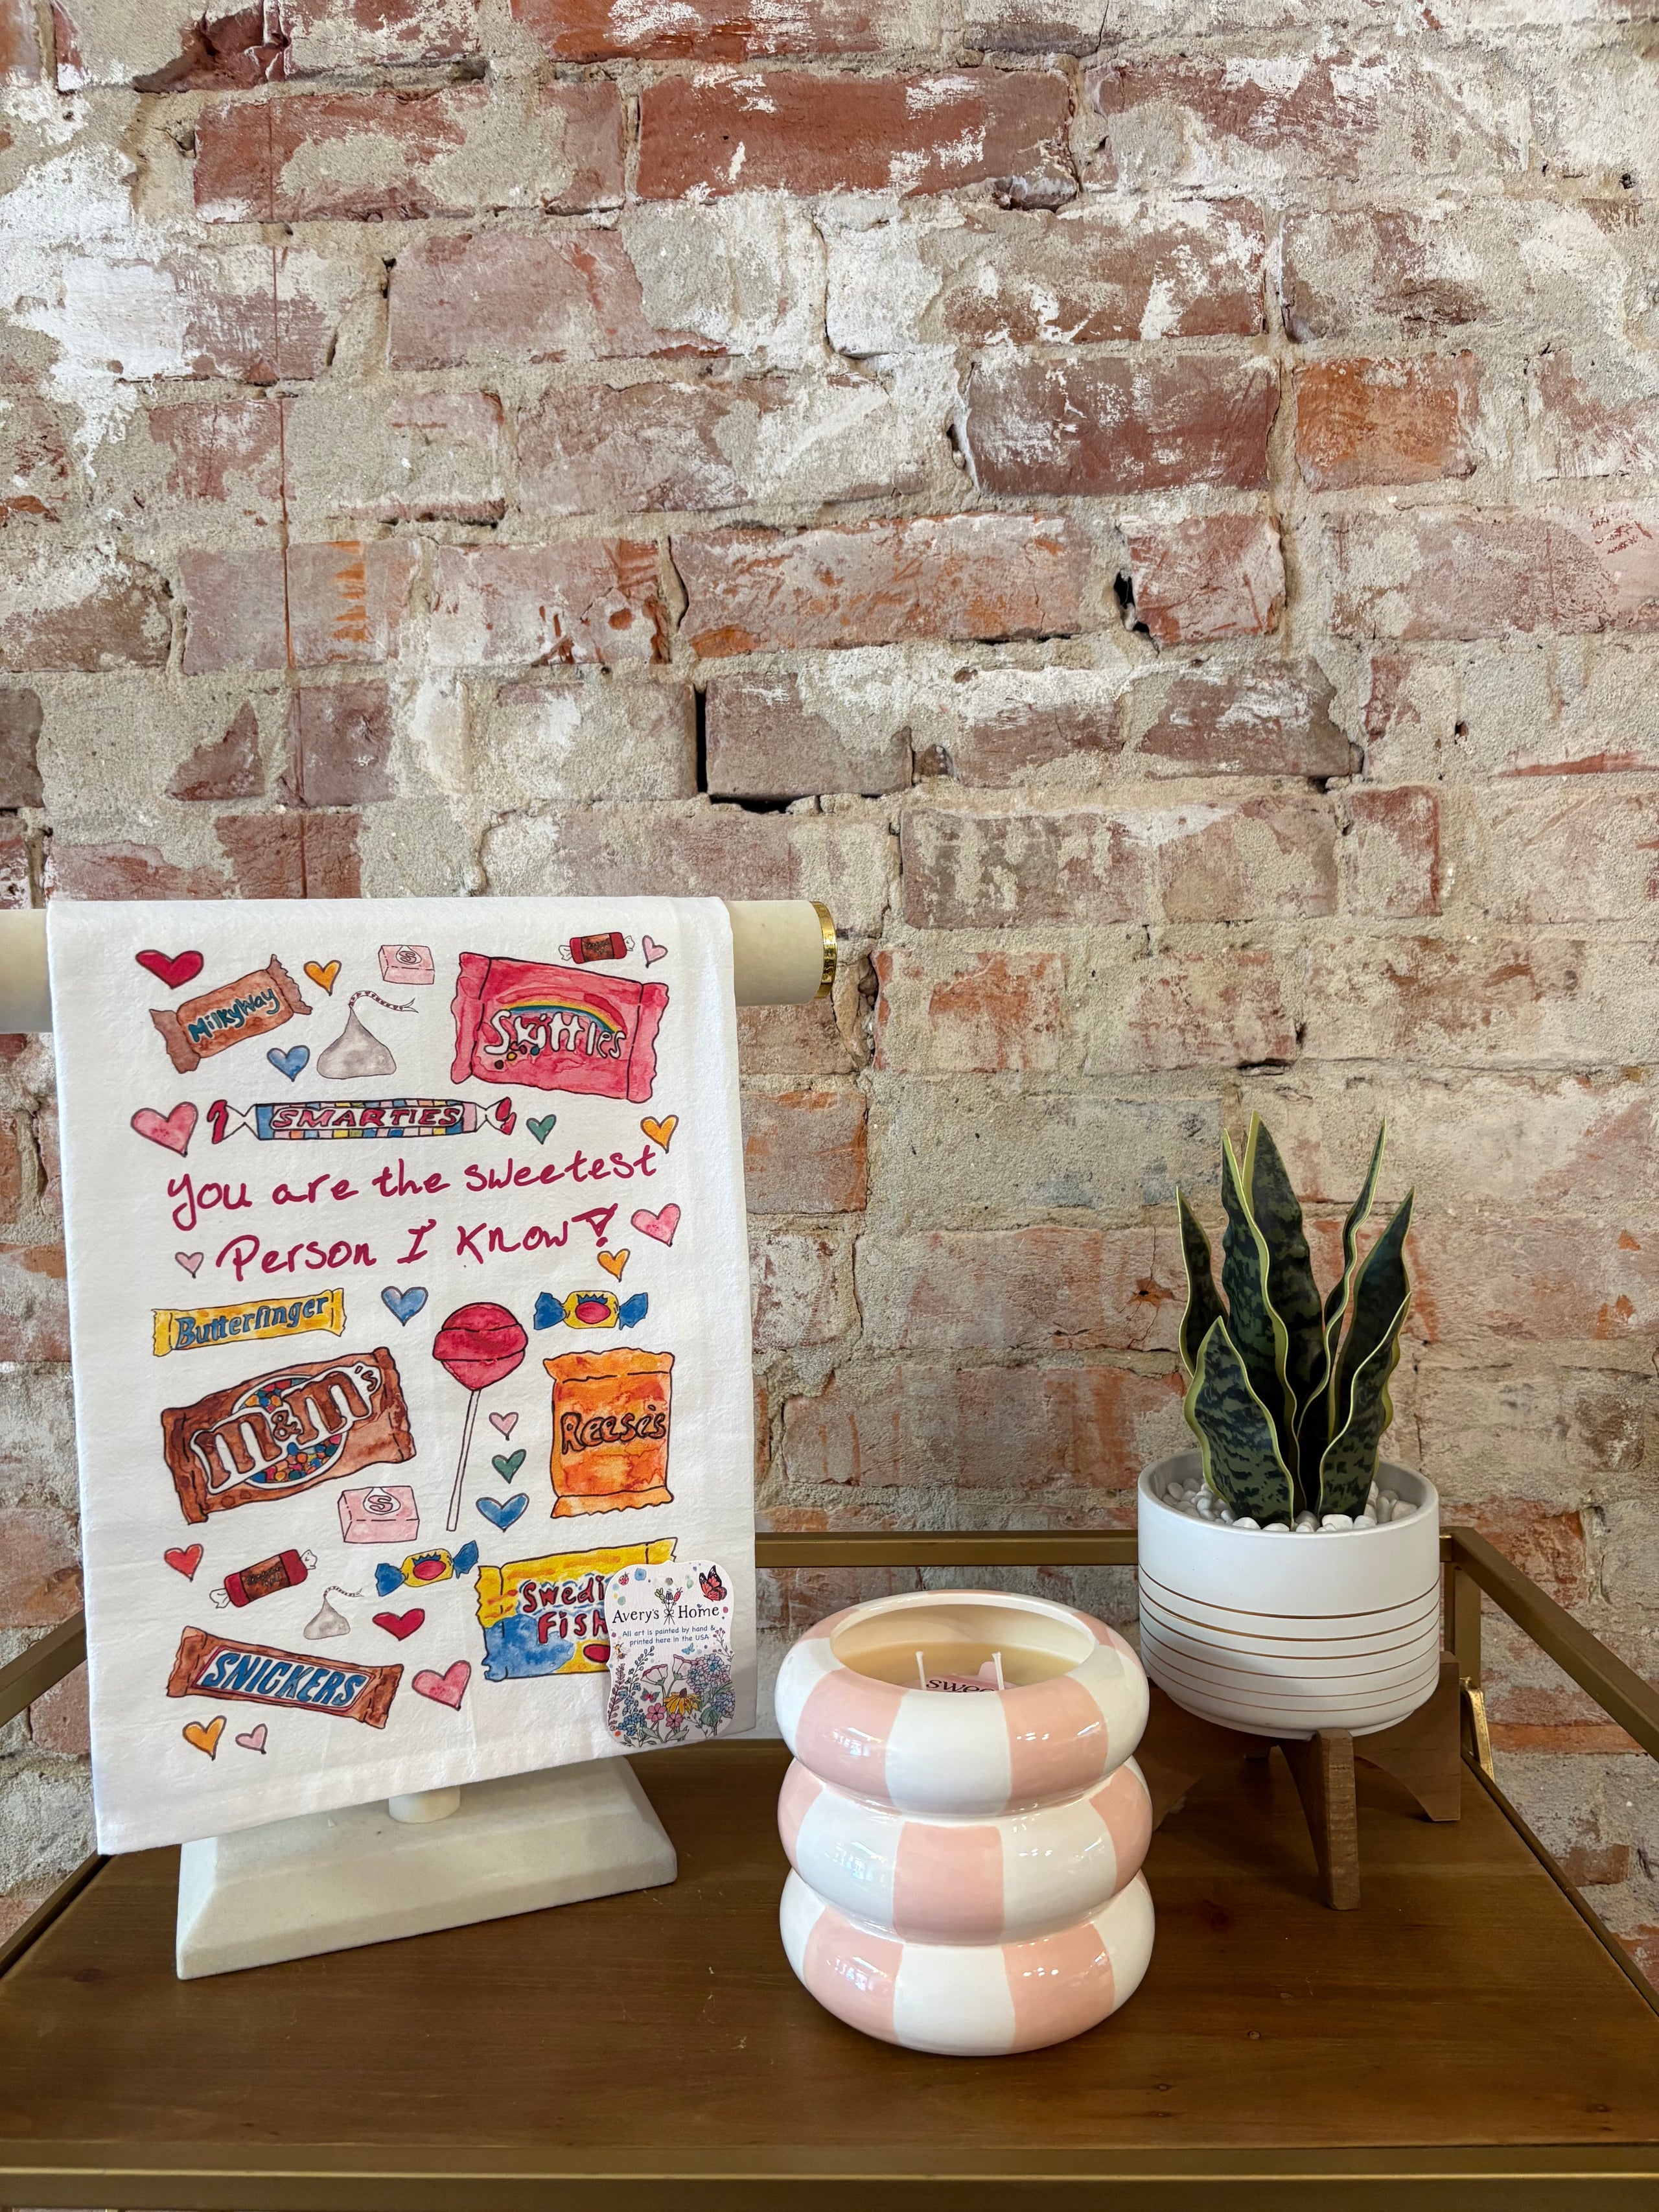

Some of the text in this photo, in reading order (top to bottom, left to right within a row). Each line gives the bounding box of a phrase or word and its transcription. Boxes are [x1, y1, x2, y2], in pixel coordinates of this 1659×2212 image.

[483, 1009, 626, 1058] Skittles
[272, 1107, 461, 1128] SMARTIES
[167, 1145, 656, 1231] you are the sweetest
[215, 1234, 377, 1281] Person
[397, 1218, 437, 1264] I
[176, 1296, 329, 1349] Butterfinger
[537, 1609, 609, 1645] Fish
[612, 1605, 719, 1624] Avery's Home
[655, 1627, 679, 1636] painted
[629, 1637, 653, 1647] printed
[202, 1652, 367, 1706] SNICKERS
[926, 1679, 995, 1692] swe
